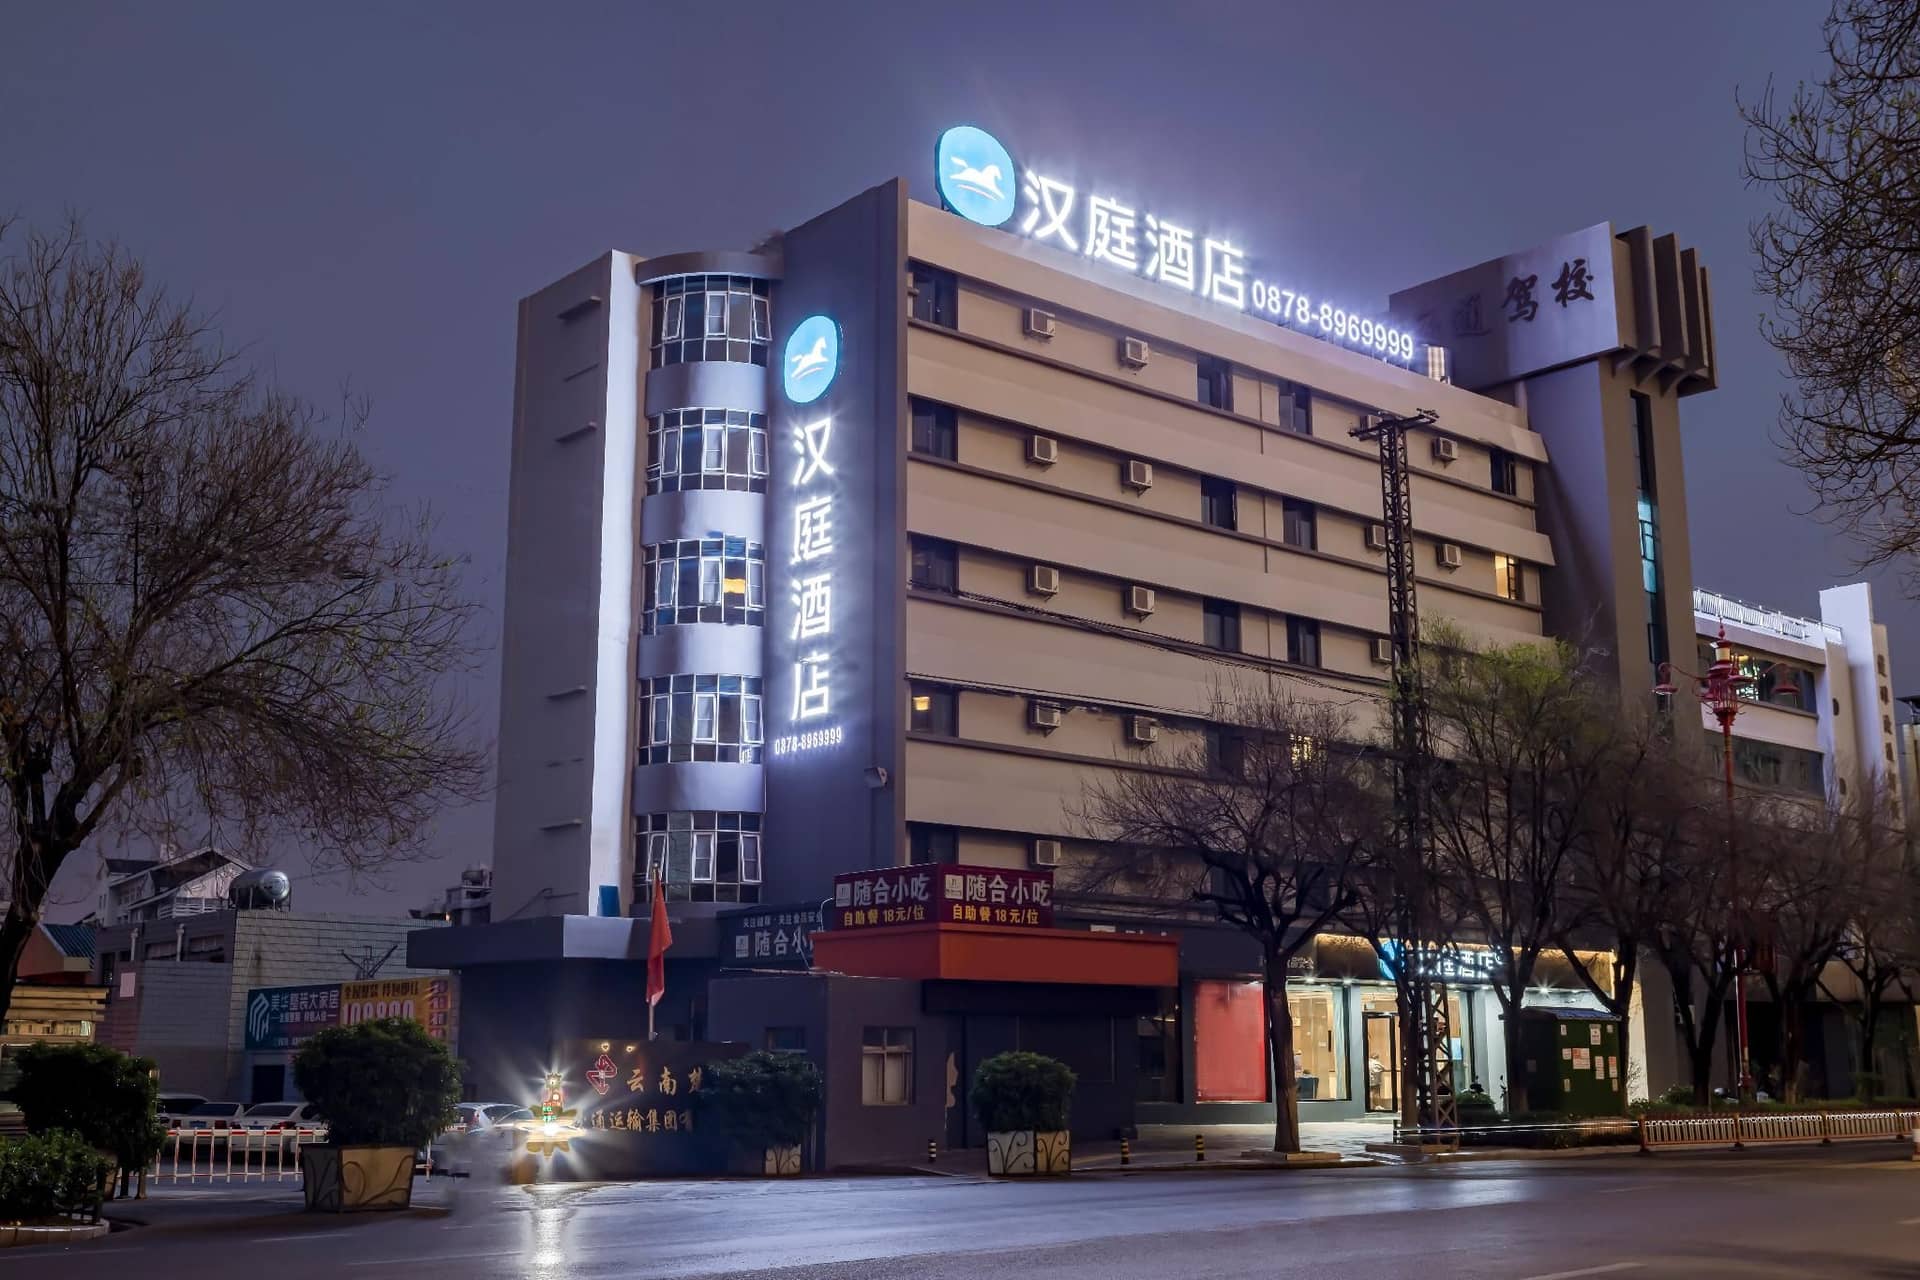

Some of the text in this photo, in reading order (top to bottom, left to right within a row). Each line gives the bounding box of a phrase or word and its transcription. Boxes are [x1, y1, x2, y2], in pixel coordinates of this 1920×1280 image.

[1021, 169, 1245, 310] 汉庭酒店
[1251, 279, 1416, 360] 0878-8969999
[790, 417, 835, 721] 汉庭酒店
[774, 727, 842, 755] 0878-8969999
[853, 873, 931, 906] 随合小吃
[966, 874, 1051, 907] 随合小吃
[844, 905, 926, 926] 自助餐 18元/位
[952, 904, 1039, 925] 自助餐 18元/位
[755, 926, 814, 957] 随合小
